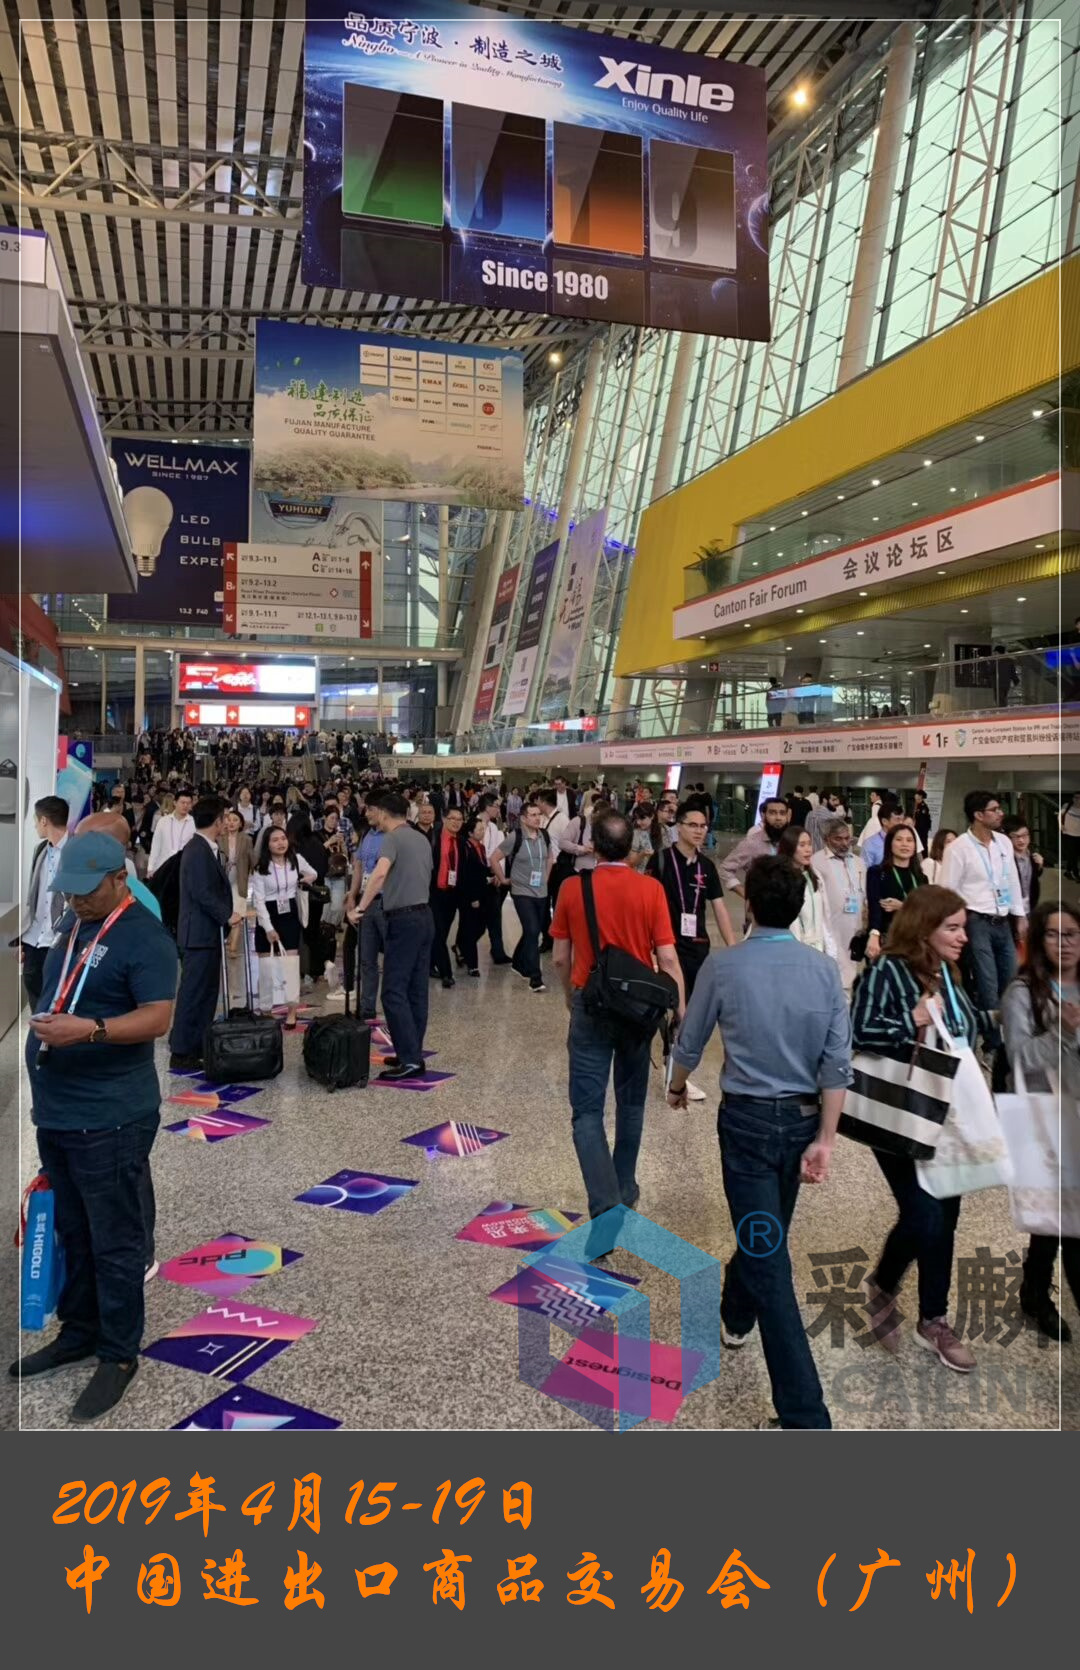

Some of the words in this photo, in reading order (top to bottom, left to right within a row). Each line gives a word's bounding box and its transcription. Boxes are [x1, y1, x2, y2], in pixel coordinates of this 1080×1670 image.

[621, 97, 648, 113] Enjoy
[651, 104, 688, 121] Quality
[689, 111, 709, 124] Life
[481, 259, 549, 292] Since
[553, 269, 609, 301] 1980
[284, 417, 312, 428] FUJIAN
[313, 420, 372, 433] MANUFACTURE
[293, 427, 327, 439] QUALITY
[328, 430, 376, 442] GUARANTEE
[124, 451, 238, 477] WELLMAX
[152, 471, 182, 480] SINCE
[278, 503, 323, 517] YUHUAN
[180, 514, 210, 526] LED
[180, 535, 221, 547] BULB
[312, 552, 321, 562] A
[842, 526, 955, 581] 会议论坛区
[312, 563, 320, 573] C
[713, 599, 748, 619] Canton
[749, 588, 769, 608] Fair
[770, 578, 807, 602] Forum
[936, 733, 949, 748] 1F
[30, 1234, 45, 1279] HIGOLD
[178, 1249, 247, 1266] pdc
[566, 1356, 683, 1391] Designest
